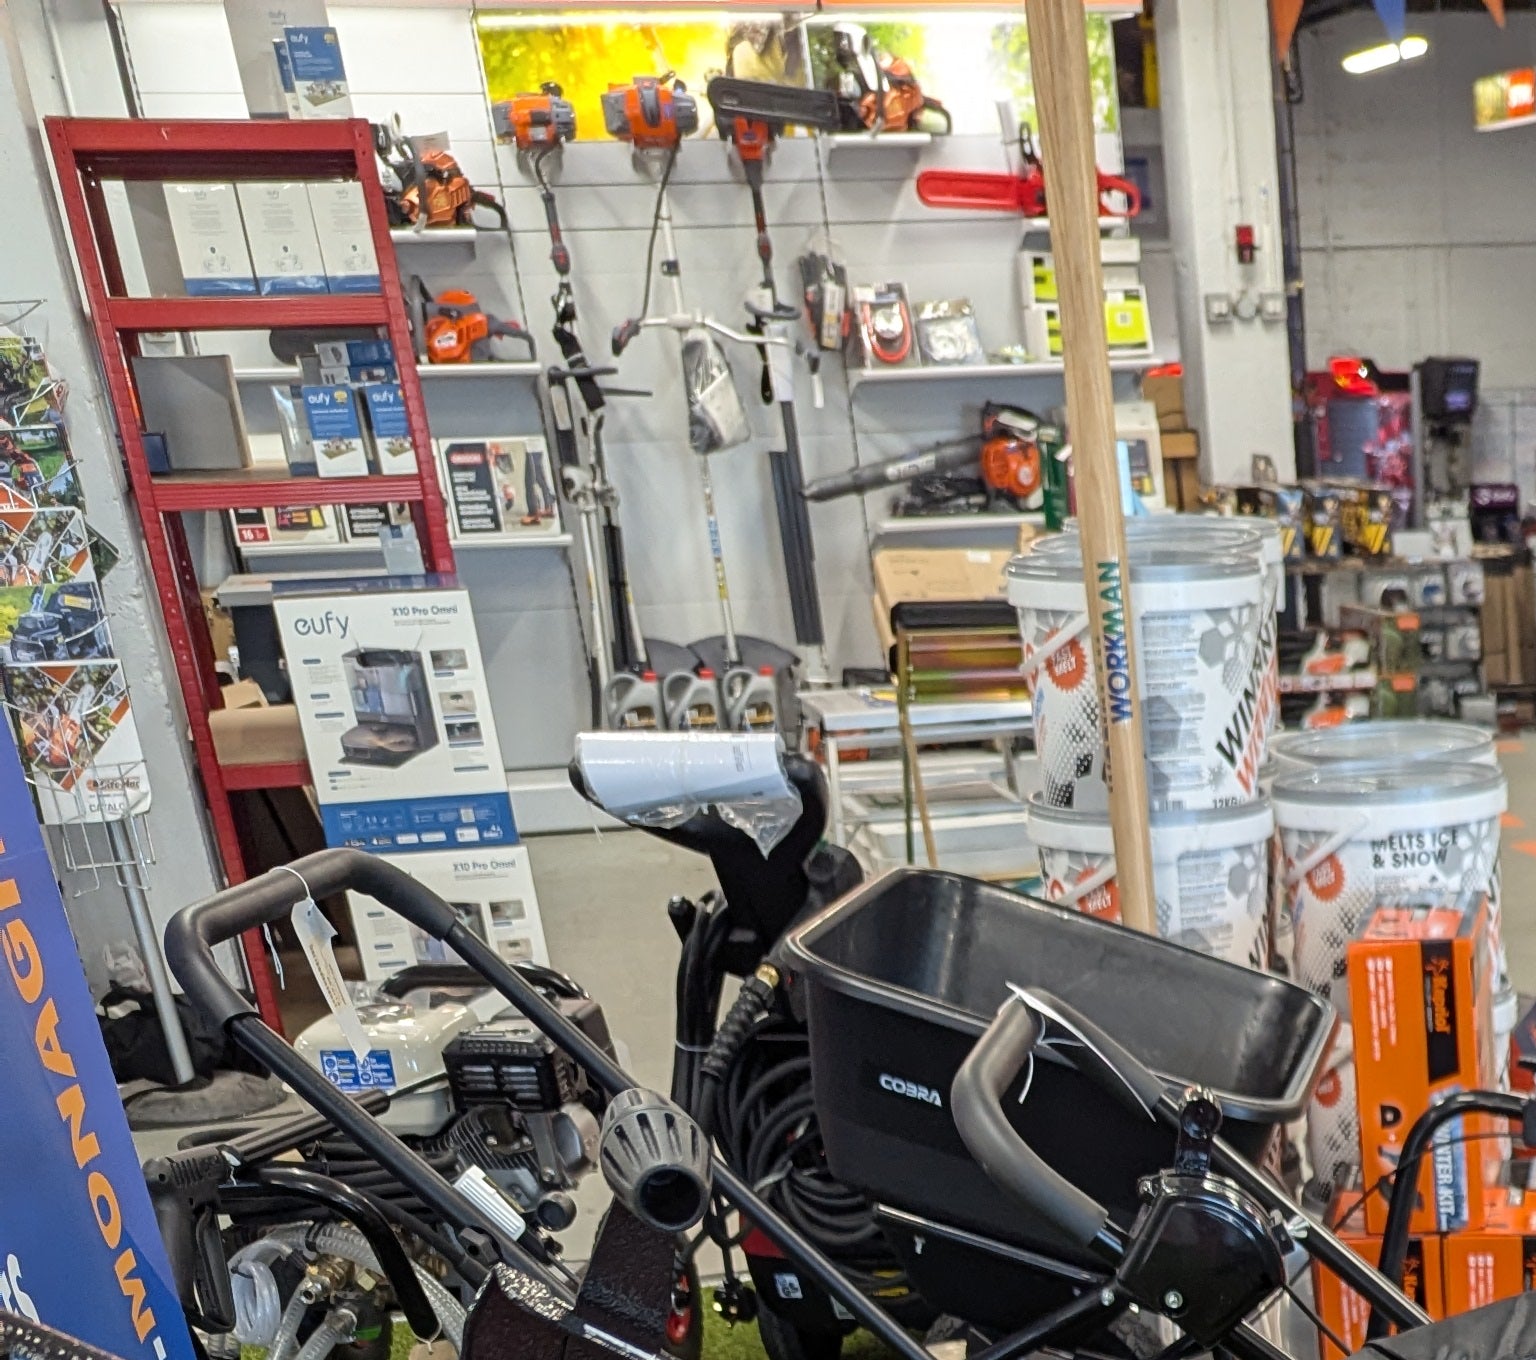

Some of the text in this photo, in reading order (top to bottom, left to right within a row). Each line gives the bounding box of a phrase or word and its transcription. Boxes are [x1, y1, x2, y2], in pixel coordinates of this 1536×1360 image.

[308, 391, 330, 405] eufy
[372, 390, 394, 403] eufy
[412, 604, 429, 616] Pro
[294, 610, 349, 639] eufy
[1097, 561, 1133, 724] WORKMAN
[1371, 829, 1459, 852] MELTS ICE
[1371, 848, 1449, 869] & SNOW
[879, 1073, 943, 1108] COBRA
